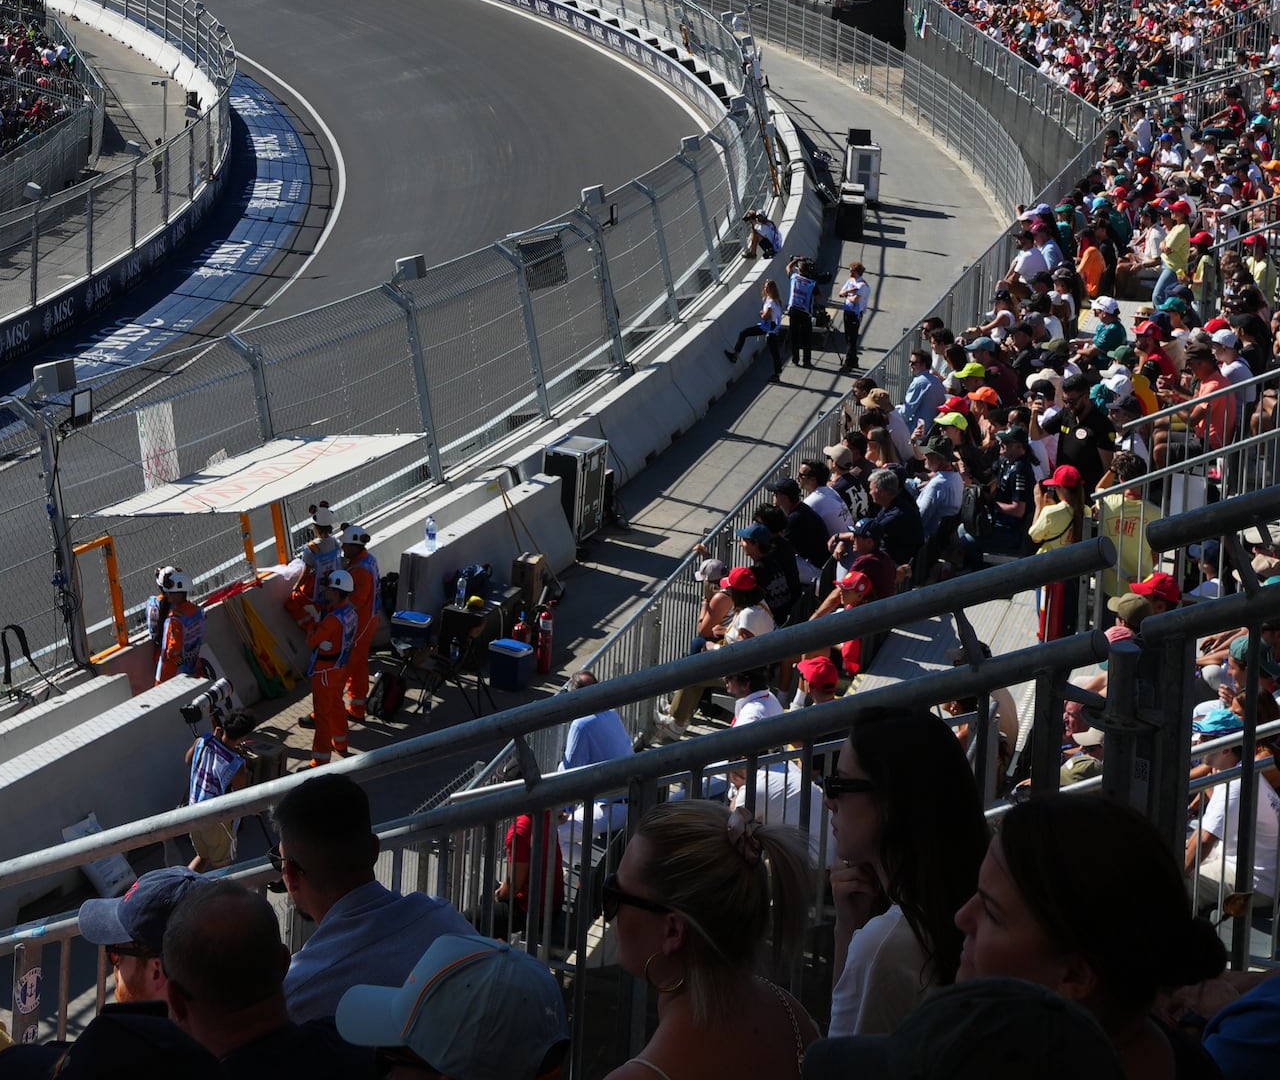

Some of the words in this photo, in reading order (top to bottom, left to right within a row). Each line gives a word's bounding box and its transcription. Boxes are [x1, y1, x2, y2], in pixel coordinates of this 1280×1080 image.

[127, 254, 142, 277] MSC
[95, 274, 112, 299] MSC
[53, 296, 74, 322] MSC
[5, 321, 30, 350] MSC
